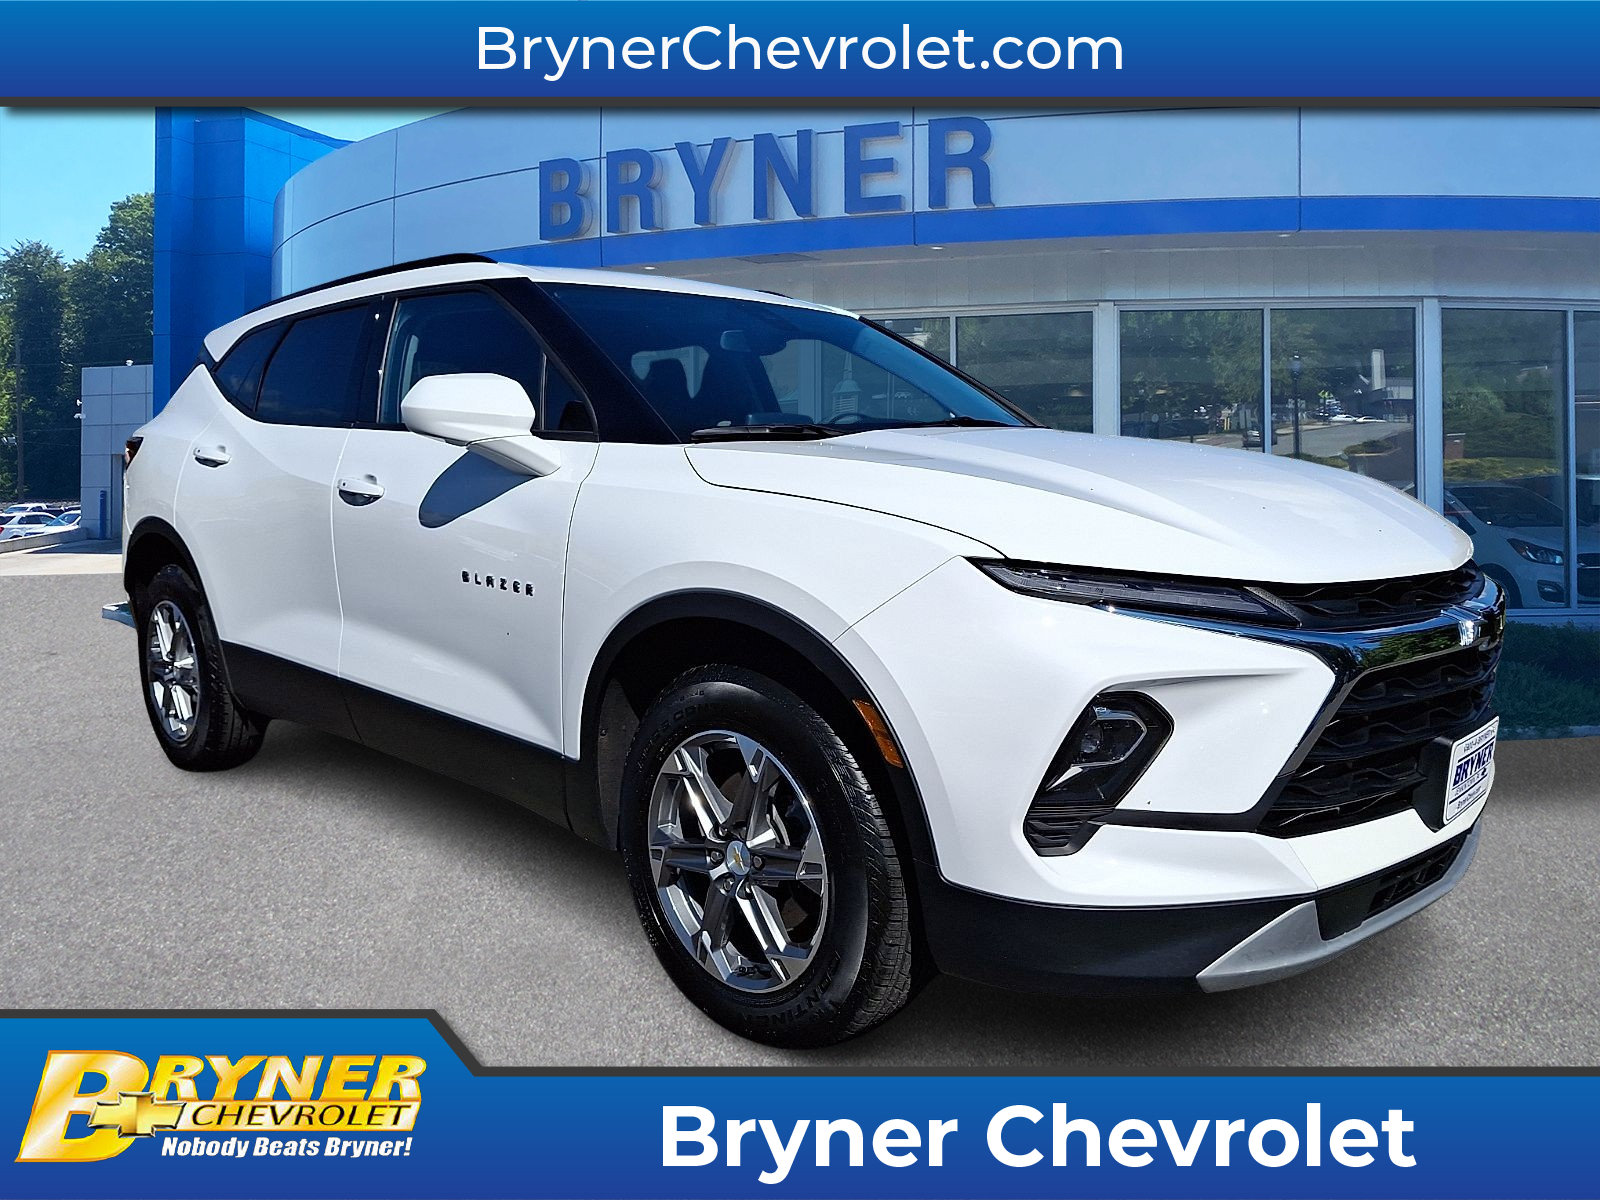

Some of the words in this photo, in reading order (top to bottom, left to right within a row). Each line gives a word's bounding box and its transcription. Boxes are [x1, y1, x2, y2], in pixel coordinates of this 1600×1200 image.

[539, 116, 995, 241] BRYNER
[461, 570, 534, 597] BLAZER
[1453, 741, 1495, 787] BRYNER
